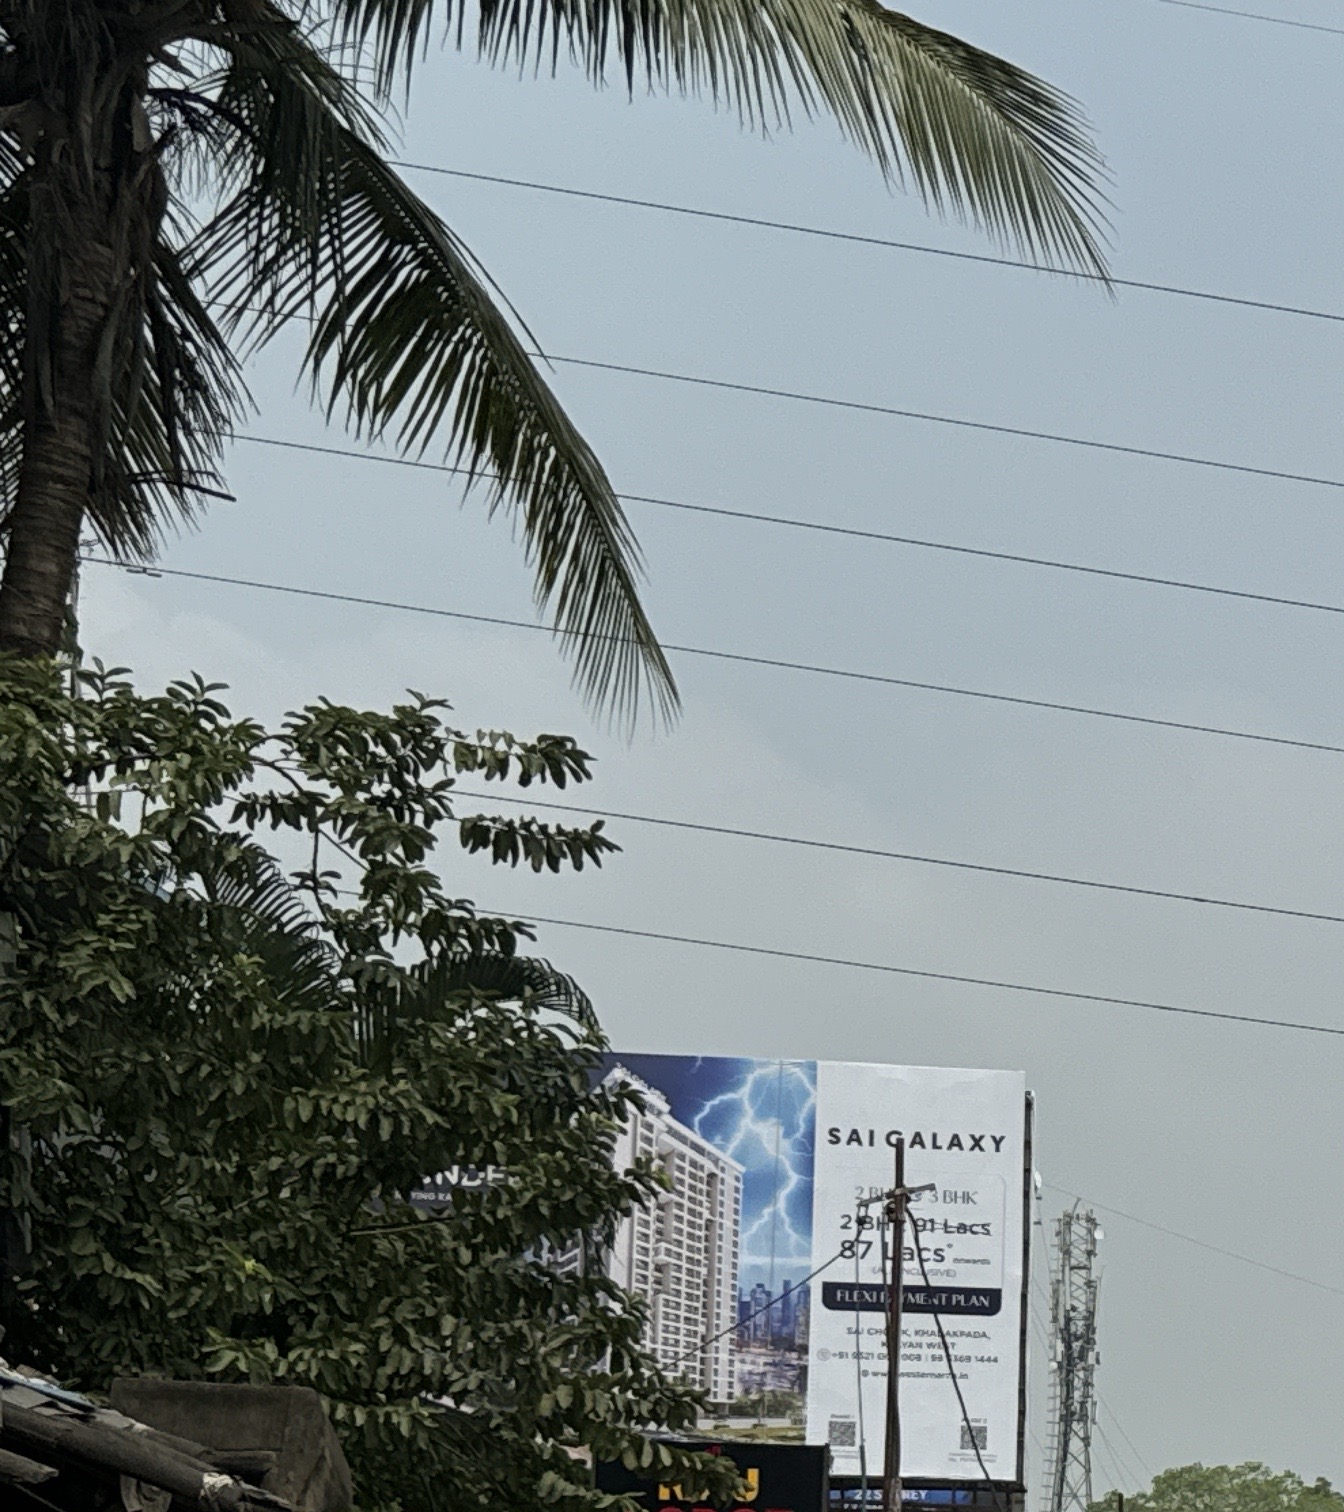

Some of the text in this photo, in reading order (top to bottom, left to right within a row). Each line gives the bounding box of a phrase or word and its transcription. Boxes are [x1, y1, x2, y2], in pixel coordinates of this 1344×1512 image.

[828, 1127, 1006, 1152] SAI GALAXY
[854, 1185, 865, 1200] 2
[928, 1189, 939, 1204] 3
[942, 1189, 978, 1205] BHK
[840, 1214, 852, 1230] 2
[944, 1218, 992, 1236] Lacs
[840, 1239, 874, 1260] 87
[836, 1289, 878, 1304] FLEXI
[951, 1293, 990, 1308] PLAN
